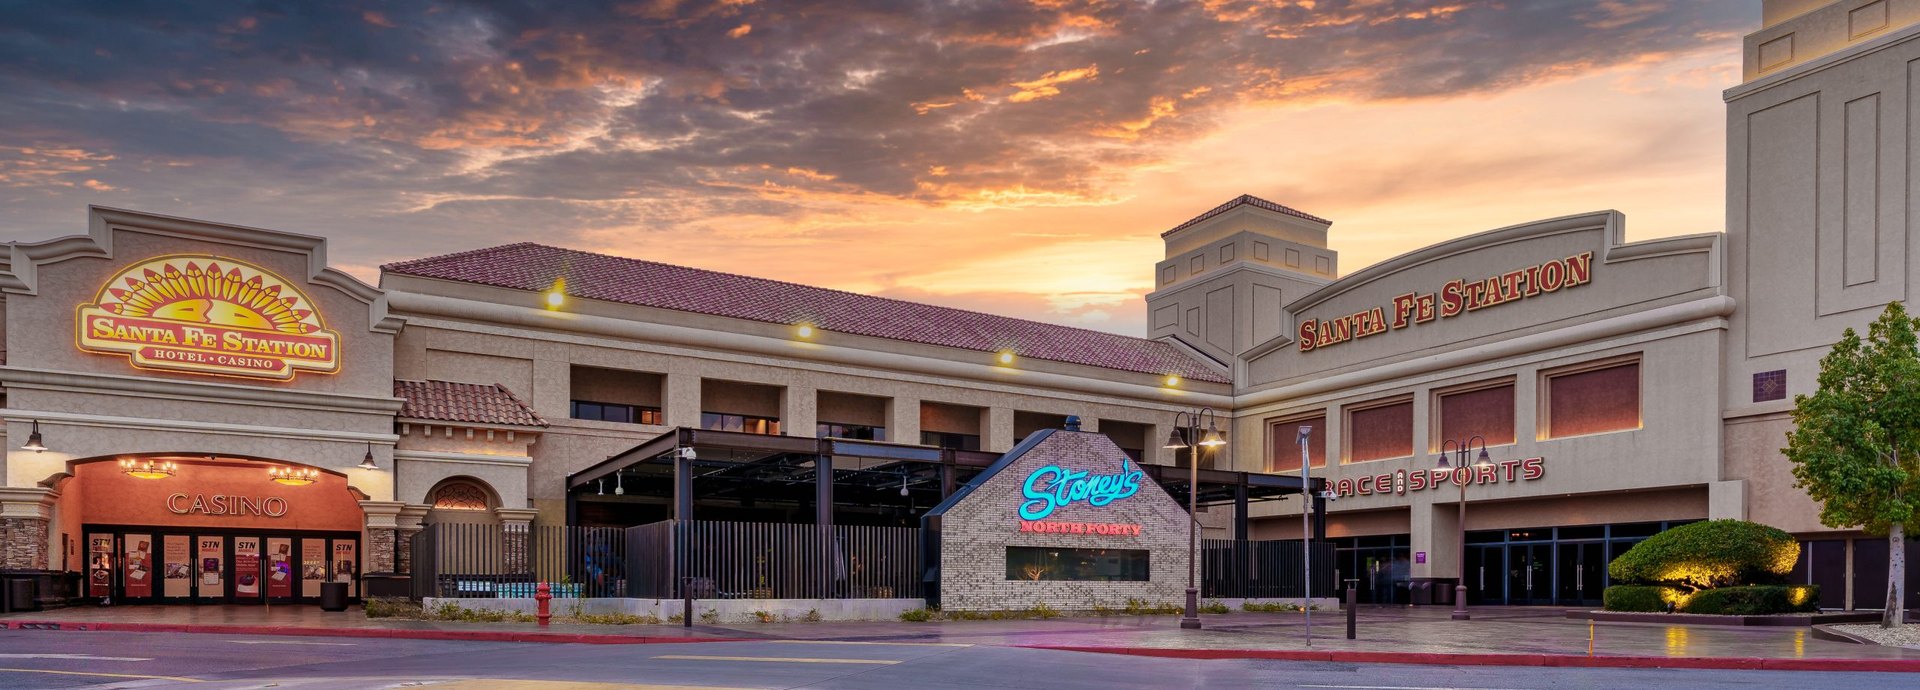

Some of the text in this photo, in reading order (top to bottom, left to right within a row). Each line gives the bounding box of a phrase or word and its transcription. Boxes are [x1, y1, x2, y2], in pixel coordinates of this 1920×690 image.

[1299, 251, 1594, 352] SANTA FE STATION
[93, 318, 327, 359] SANTA FE STATION
[154, 349, 273, 369] HOTEL CASINO
[1409, 457, 1543, 491] SPORTS
[167, 493, 288, 517] CASINO
[1019, 521, 1142, 536] NORTH FORTY
